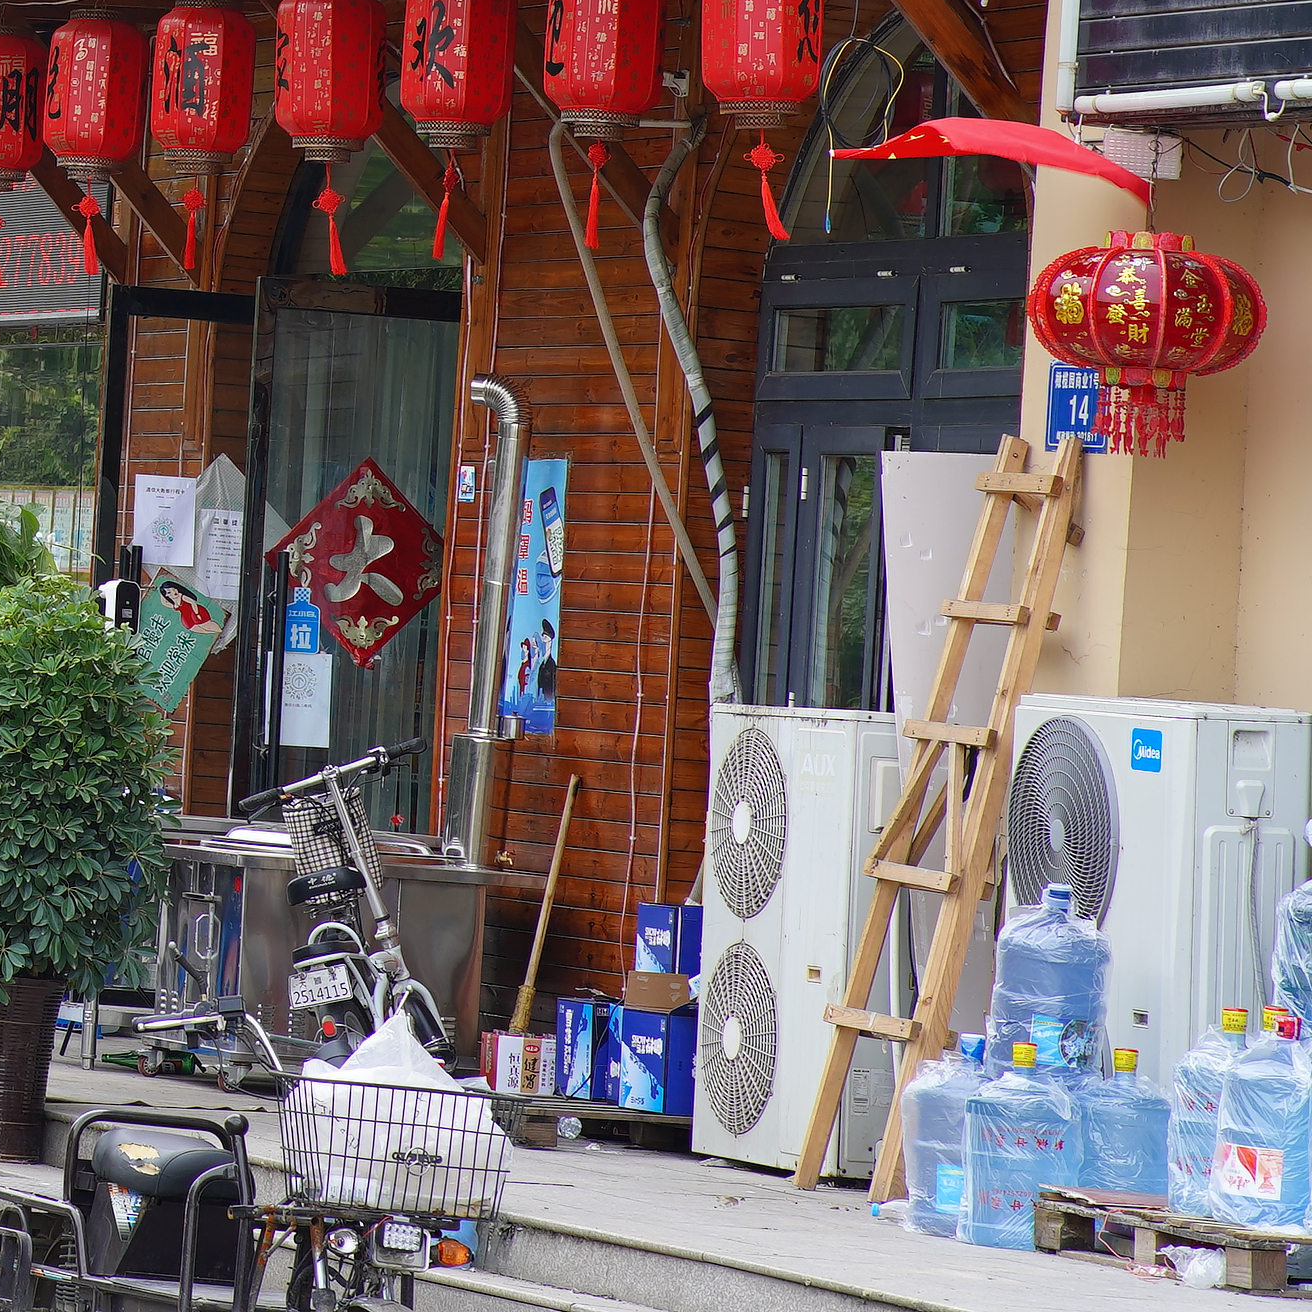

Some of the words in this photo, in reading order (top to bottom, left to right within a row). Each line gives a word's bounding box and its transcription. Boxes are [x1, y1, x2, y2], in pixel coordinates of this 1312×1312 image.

[1069, 394, 1089, 426] 14
[323, 514, 404, 608] 大
[288, 609, 317, 618] 江小白
[290, 623, 312, 650] 拉
[1134, 739, 1161, 761] Midea
[293, 981, 349, 1006] 2514115
[507, 1052, 521, 1089] 恒真源
